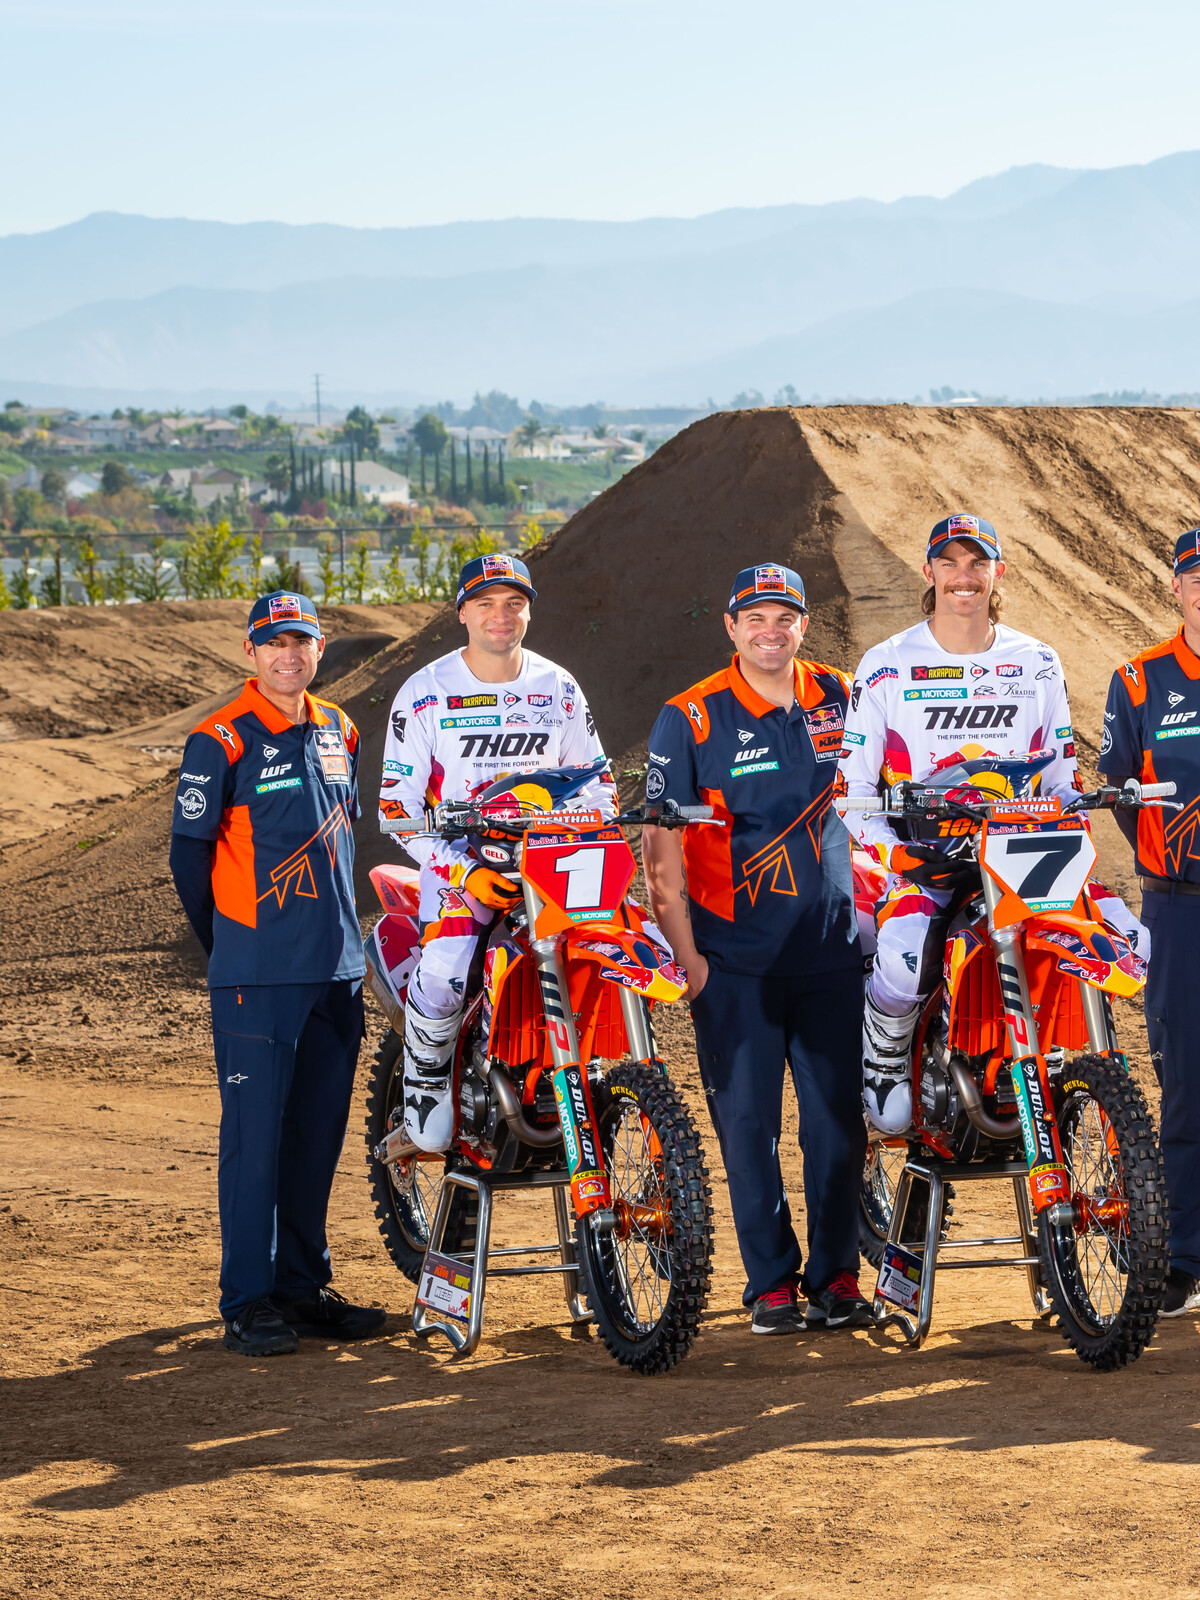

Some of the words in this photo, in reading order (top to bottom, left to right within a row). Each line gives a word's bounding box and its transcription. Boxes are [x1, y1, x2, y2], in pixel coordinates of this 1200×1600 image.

[866, 667, 898, 685] PARTS
[997, 666, 1021, 676] 100%
[529, 695, 552, 706] 100%
[922, 689, 963, 699] MOTOREX
[456, 717, 497, 726] MOTOREX
[924, 705, 1018, 730] THOR
[808, 724, 826, 734] Red
[826, 718, 843, 731] Bull
[459, 733, 550, 758] THOR
[819, 734, 843, 747] KTM
[385, 761, 408, 775] TOREX
[743, 762, 777, 773] MOTOREX
[268, 778, 300, 791] MOTOREX
[989, 827, 1003, 835] Red
[1003, 825, 1018, 833] Bull
[1057, 821, 1081, 830] KTM
[529, 837, 543, 845] Red
[543, 836, 558, 844] Bull
[597, 831, 620, 840] KTM
[485, 849, 505, 860] BELL
[1006, 835, 1083, 899] 7
[554, 847, 606, 910] 1
[1062, 1080, 1090, 1093] DUNLOP
[1016, 1095, 1036, 1157] MOTOREX
[558, 1102, 579, 1164] MOTOREX
[434, 1264, 449, 1279] KTM
[881, 1266, 892, 1288] 7
[425, 1277, 434, 1298] 1
